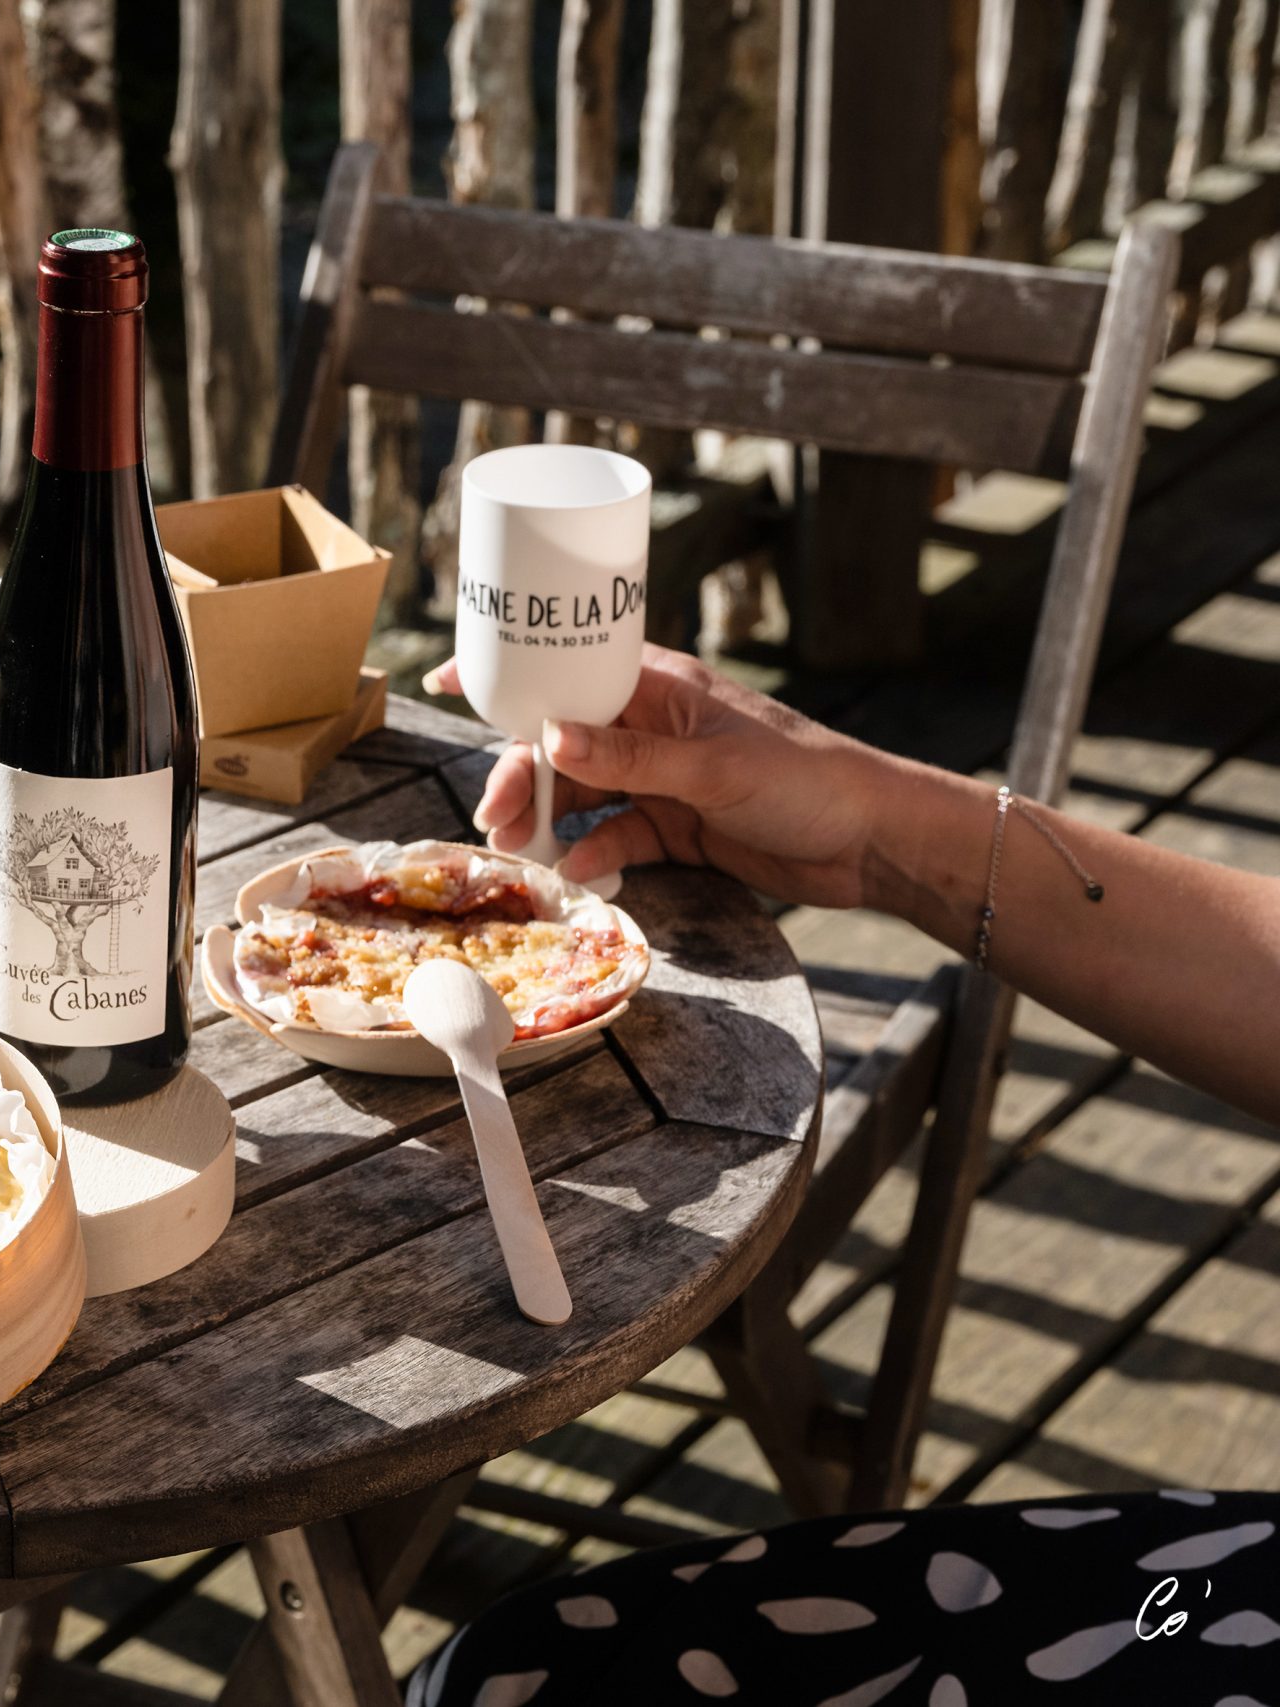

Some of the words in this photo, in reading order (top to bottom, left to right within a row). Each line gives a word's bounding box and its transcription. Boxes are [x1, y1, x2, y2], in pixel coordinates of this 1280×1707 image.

[527, 594, 562, 629] DE
[573, 594, 601, 628] LA
[524, 635, 540, 647] 04
[544, 635, 557, 647] 74
[561, 636, 577, 648] 30
[580, 634, 594, 647] 32
[597, 632, 610, 645] 32
[21, 984, 42, 1005] des
[49, 977, 148, 1021] Cabanes
